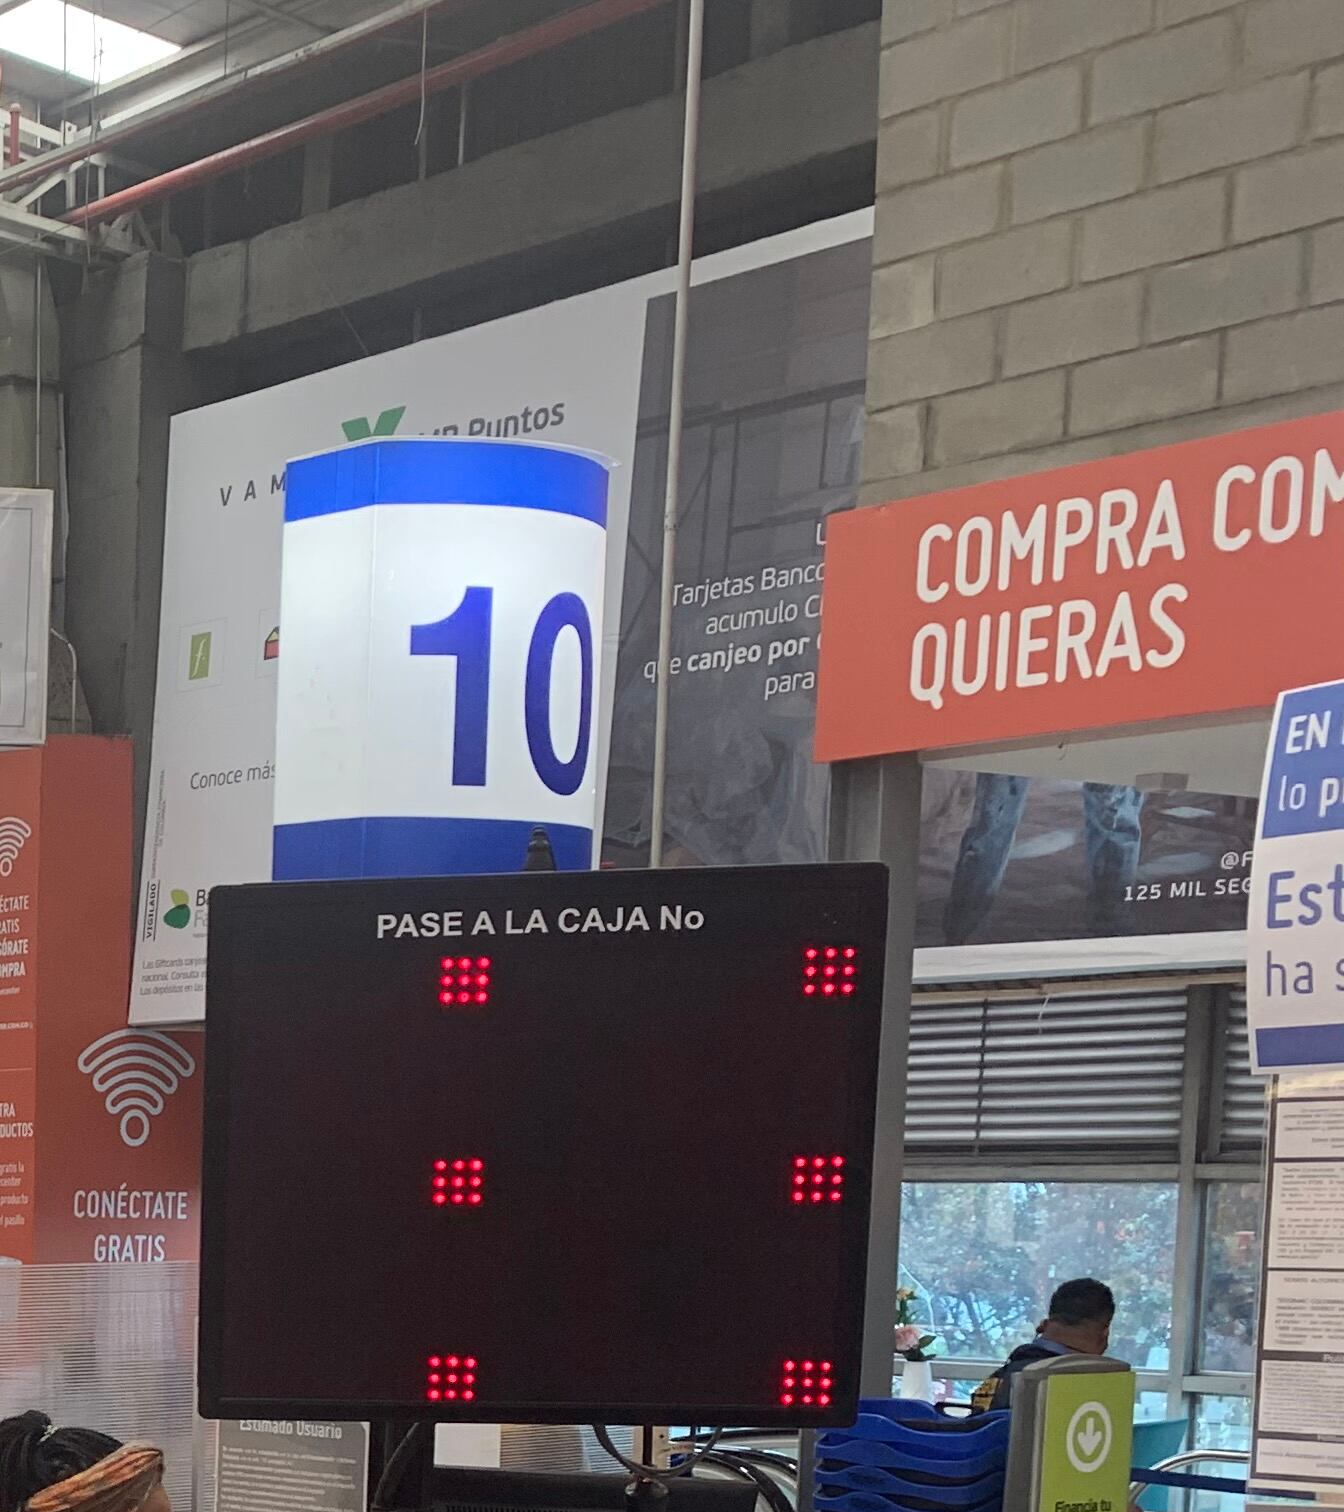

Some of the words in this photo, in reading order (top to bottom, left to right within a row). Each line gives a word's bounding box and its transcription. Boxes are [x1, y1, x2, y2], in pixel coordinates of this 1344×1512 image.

[915, 478, 1186, 604] COMPRA
[672, 576, 754, 607] Tarjetas
[705, 600, 798, 635] acumulo
[687, 643, 762, 672] canjeo
[768, 637, 810, 665] por
[910, 583, 1189, 710] QUIERAS
[410, 586, 594, 796] 10
[765, 671, 815, 701] para
[1285, 710, 1331, 755] EN
[190, 768, 243, 790] Conoce
[1278, 775, 1306, 812] lo
[1124, 883, 1162, 902] 125
[1170, 879, 1206, 899] MIL
[146, 883, 157, 939] VIGILADO
[377, 912, 464, 939] PASE
[470, 911, 498, 938] A
[505, 909, 547, 937] LA
[557, 906, 651, 936] CAJA
[659, 904, 706, 932] No
[1266, 950, 1314, 997] ha
[73, 1182, 188, 1220] CONÉCTATE
[94, 1233, 166, 1263] GRATIS
[296, 1421, 343, 1440] Usuario
[1101, 1499, 1111, 1512] tu
